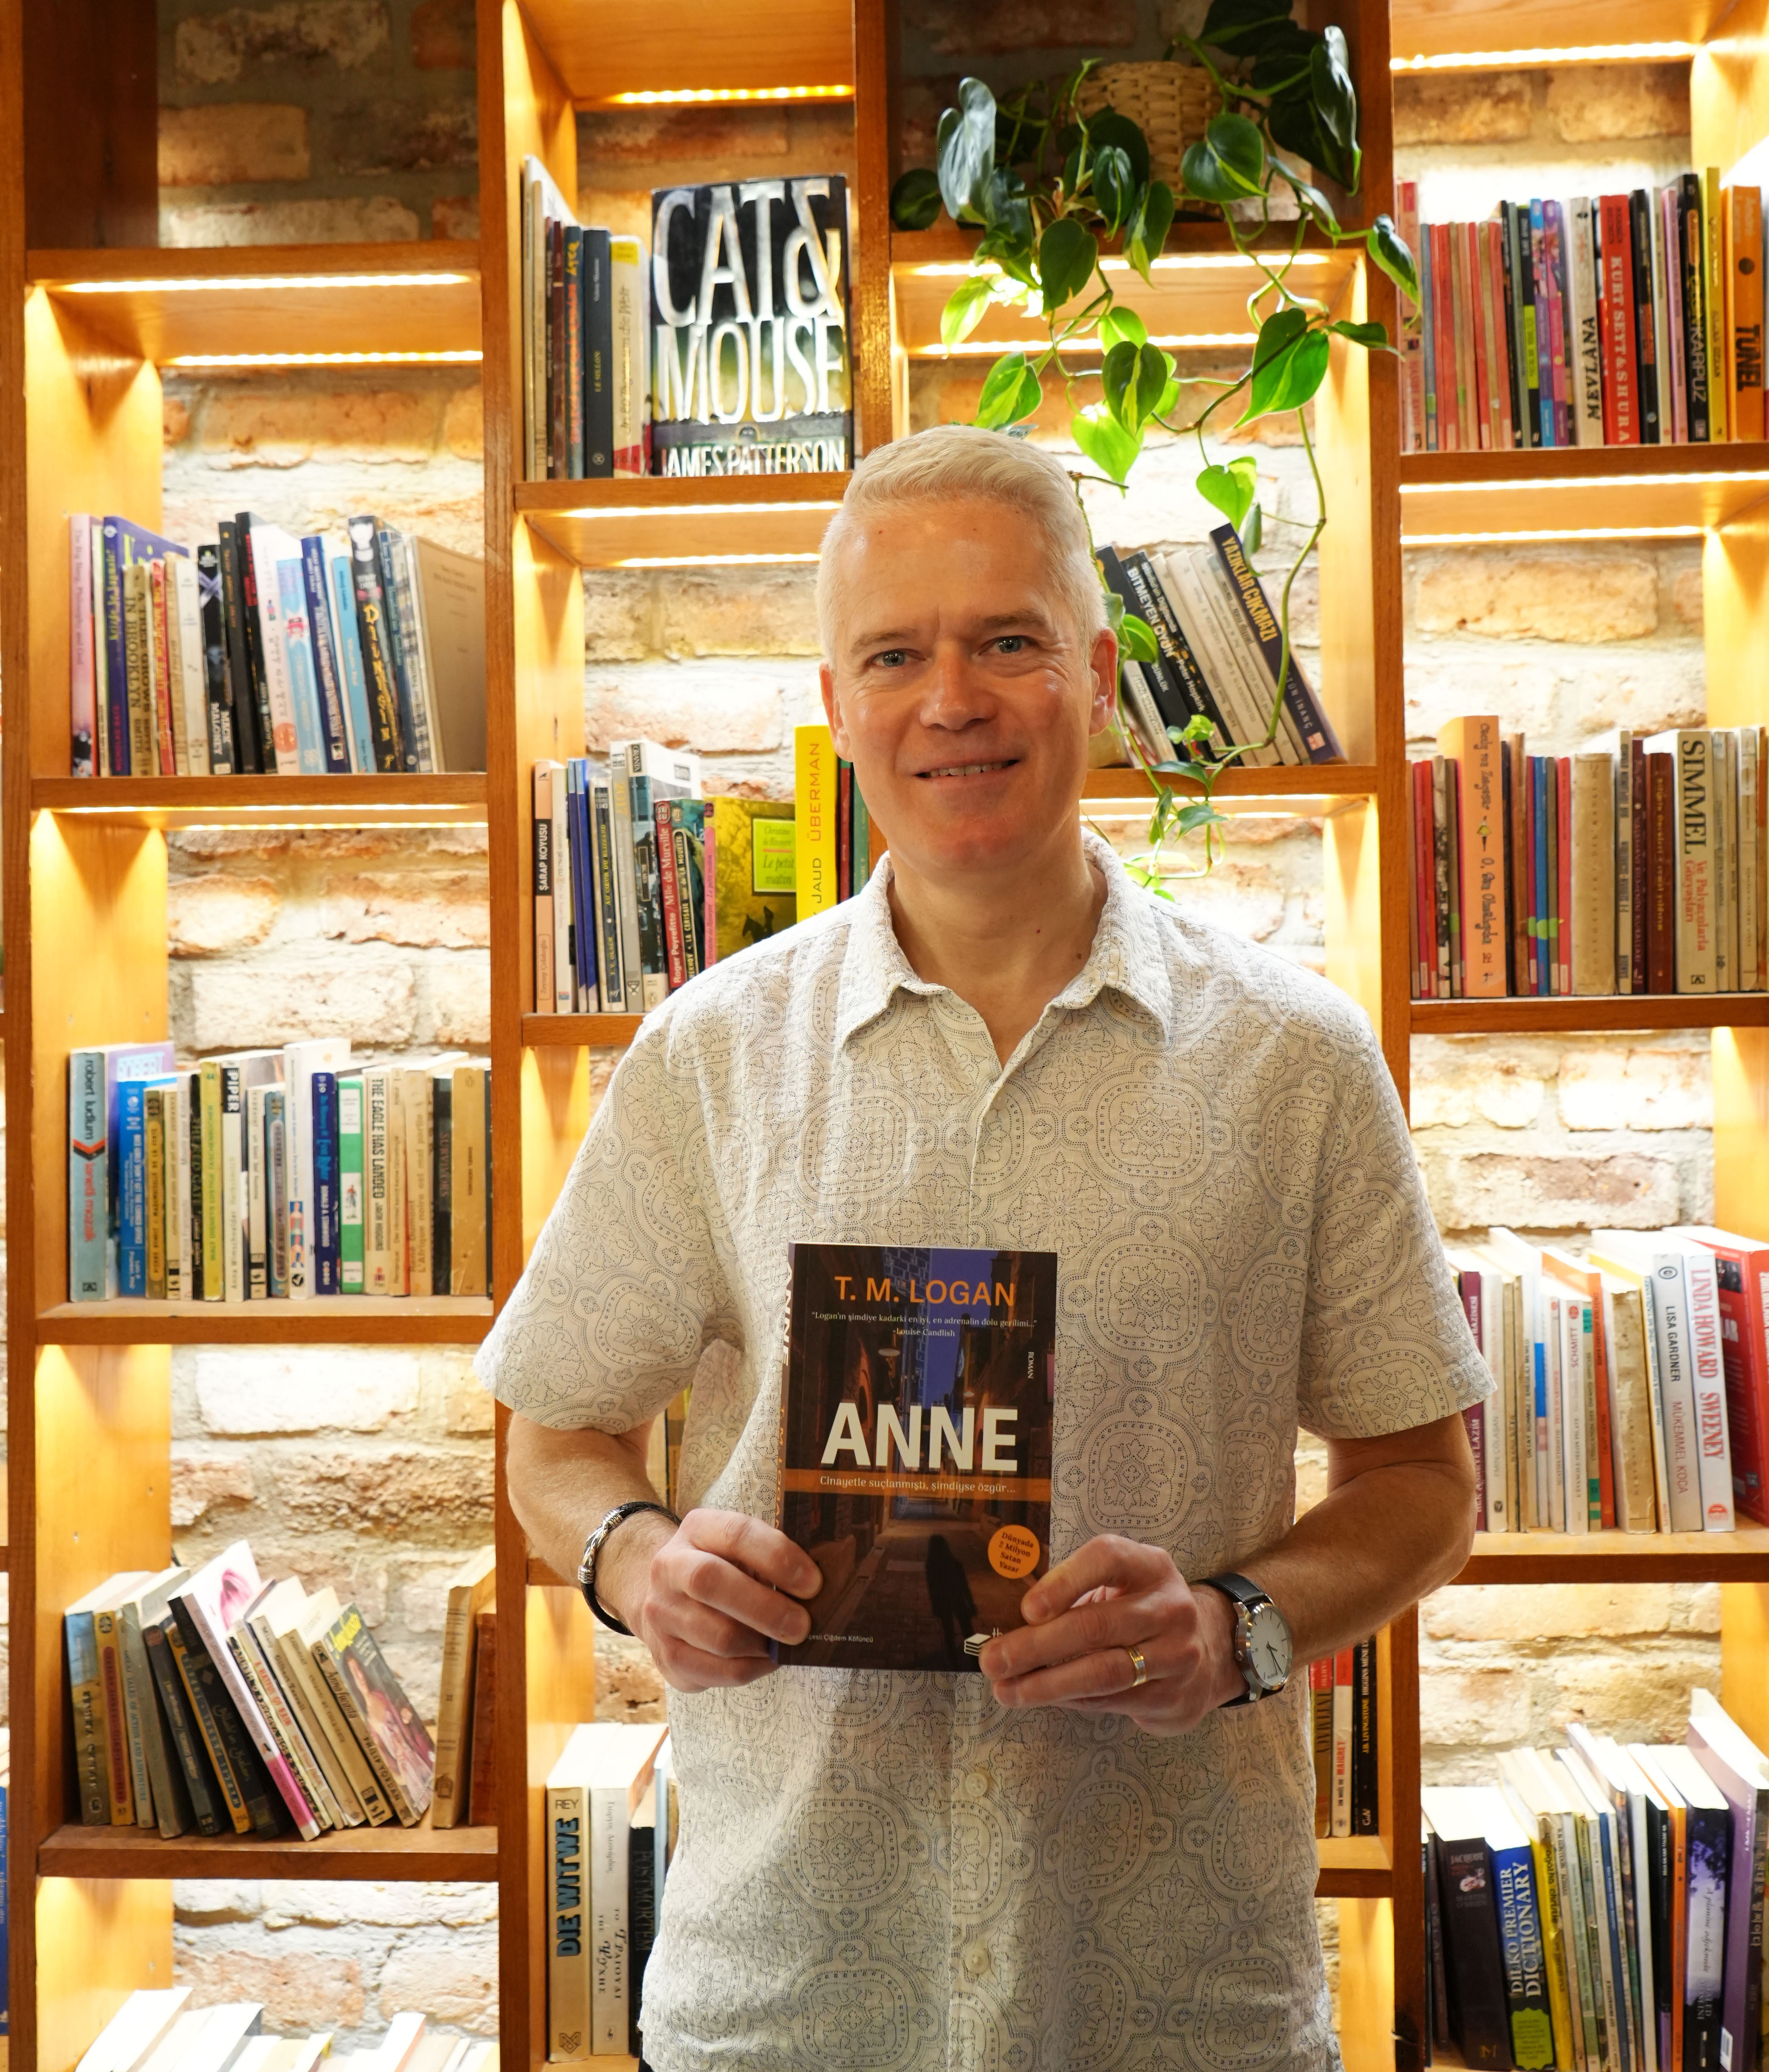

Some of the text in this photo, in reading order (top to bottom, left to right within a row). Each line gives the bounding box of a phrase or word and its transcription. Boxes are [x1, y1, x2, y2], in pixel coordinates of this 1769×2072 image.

[654, 182, 785, 327] CAT
[1610, 256, 1631, 442] KURT SEYT SHURA
[1690, 326, 1706, 402] KARPUZ
[656, 316, 845, 425] MOUSE
[730, 436, 845, 476] PATTERSON
[1222, 536, 1277, 643] YAZIKLAR ÇIKMAZI
[127, 597, 140, 707] IN BROOKLYN
[1150, 624, 1175, 657] OYUN
[141, 654, 150, 713] GROWS
[1187, 680, 1205, 713] Hopkirk
[211, 702, 223, 756] MALONEY
[221, 710, 230, 744] MACK
[614, 782, 628, 815] 2017
[1682, 740, 1707, 855] SIMMEL
[807, 742, 822, 904] JAUD ÜBERMAN
[539, 823, 549, 891] ŞARAP KOYUSU
[603, 860, 609, 870] DU
[659, 828, 671, 869] Murville
[677, 835, 685, 864] MOUETTE
[763, 853, 795, 871] Le petit
[663, 871, 672, 883] de
[680, 867, 686, 875] LA
[669, 912, 680, 955] Peyrefitte
[682, 903, 692, 931] CERISAIE
[686, 934, 693, 942] LA
[673, 958, 682, 983] Roger
[84, 1060, 97, 1140] robert ludlum
[227, 1070, 239, 1112] PIPER
[372, 1079, 385, 1199] THE EAGLE HAS LANDED
[440, 1133, 450, 1197] SURVIVORS
[835, 1277, 1015, 1306] T. M. LOGAN
[782, 1265, 792, 1367] ANNE
[848, 1312, 877, 1322] şimdiye
[879, 1314, 906, 1323] kadarki
[920, 1315, 931, 1326] iyi,
[944, 1317, 980, 1325] adrenalin
[981, 1318, 998, 1326] dolu
[923, 1328, 955, 1337] Candlish
[1569, 1327, 1579, 1368] SCHMITT
[1691, 1269, 1724, 1460] LINDA HOWARD SWEENEY
[1666, 1306, 1688, 1493] LISA GARDNER MÜKEMMEL KOCA
[821, 1402, 1019, 1472] ANNE
[1470, 1419, 1480, 1449] LAZIM
[820, 1476, 1016, 1494] Cinayetle suçlanmıştı, şimdiyse özgür...
[1000, 1552, 1022, 1565] Satan
[1002, 1531, 1034, 1549] Dünyada
[1005, 1542, 1031, 1557] Milyon
[999, 1561, 1020, 1574] Yazar
[824, 1634, 847, 1643] Çiğdem
[1336, 1741, 1346, 1776] MAIGRET
[376, 1763, 402, 1803] YORDAN
[555, 1799, 579, 1810] REY
[555, 1817, 582, 1957] DIE WITWE
[633, 1850, 654, 1950] POSTMORTEM
[1500, 1868, 1519, 1938] PREMIER
[1545, 1850, 1559, 1924] agatha christie
[1513, 1862, 1542, 1997] DICTIONARY
